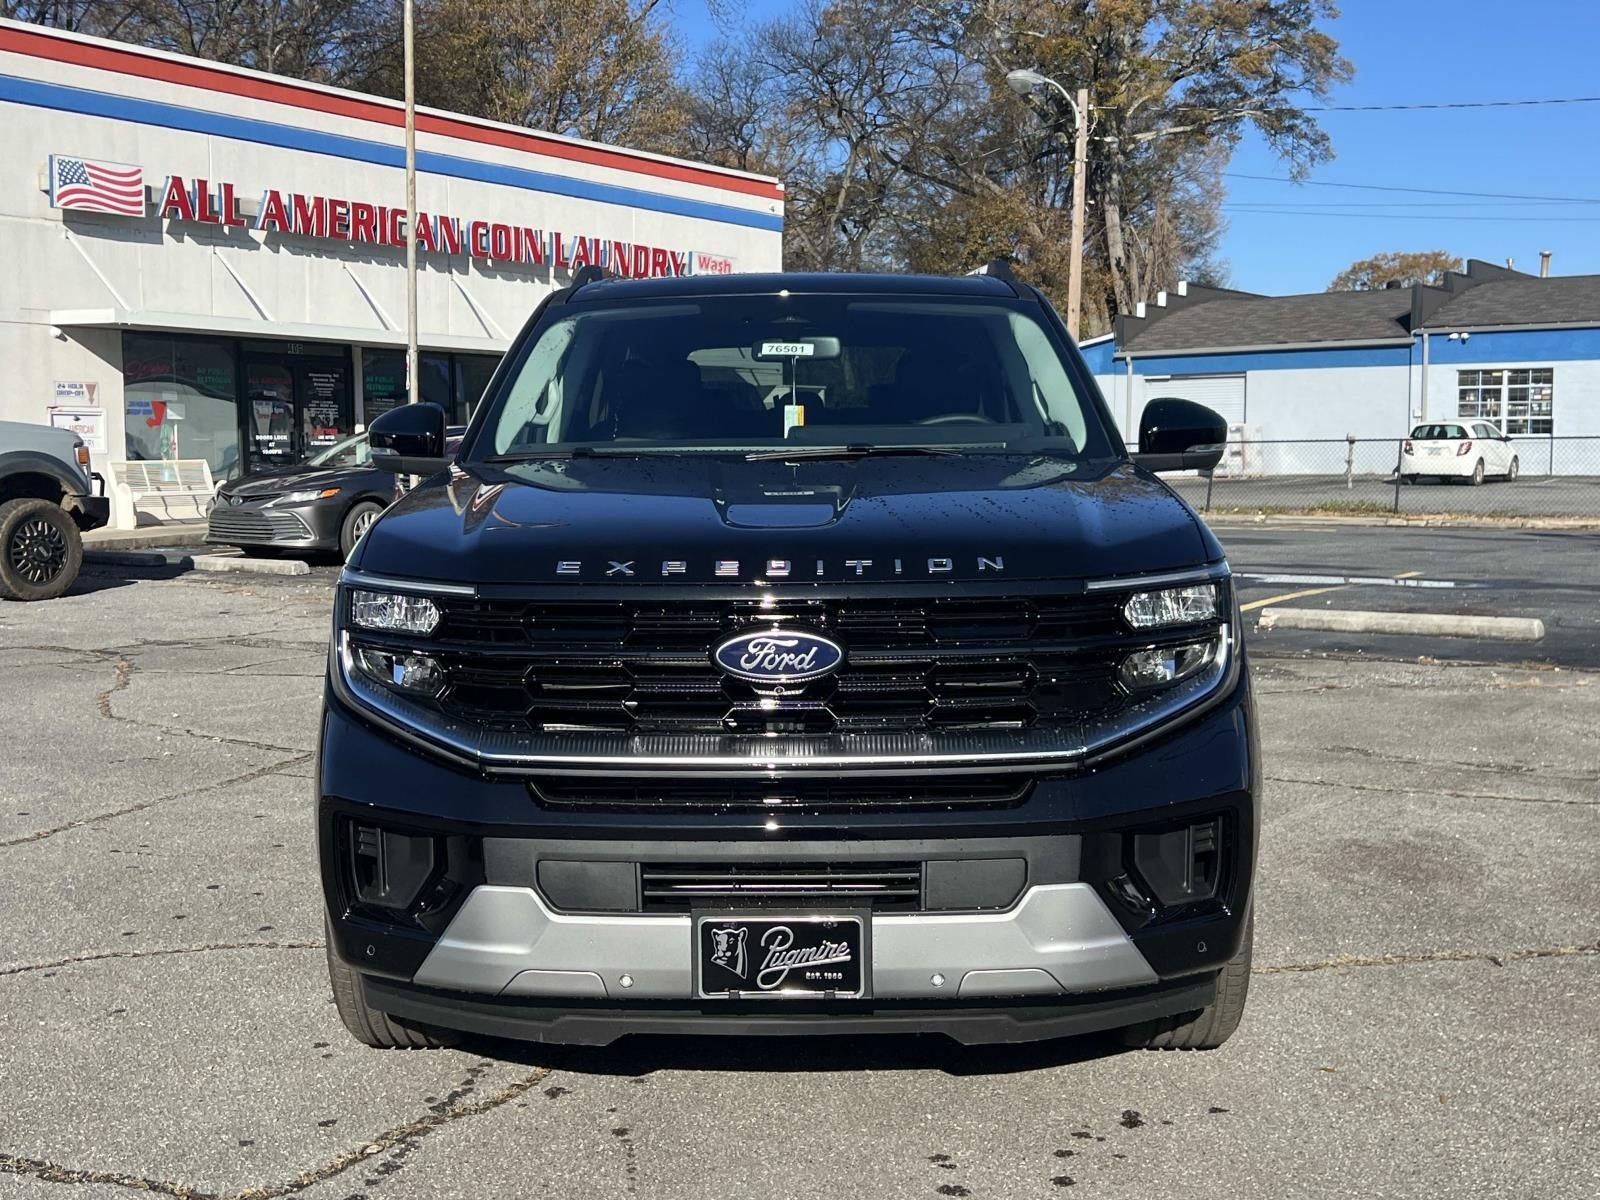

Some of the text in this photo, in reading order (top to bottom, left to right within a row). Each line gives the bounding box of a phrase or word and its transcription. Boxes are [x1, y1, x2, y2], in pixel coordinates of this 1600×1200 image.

[157, 175, 686, 279] ALL AMERICAN COIN LAUNDRY
[698, 254, 732, 273] Wash
[768, 345, 805, 353] 76501
[555, 556, 1005, 577] EXPEDITION
[739, 638, 818, 672] Ford
[757, 925, 851, 990] Pugmire
[805, 971, 822, 980] EST.
